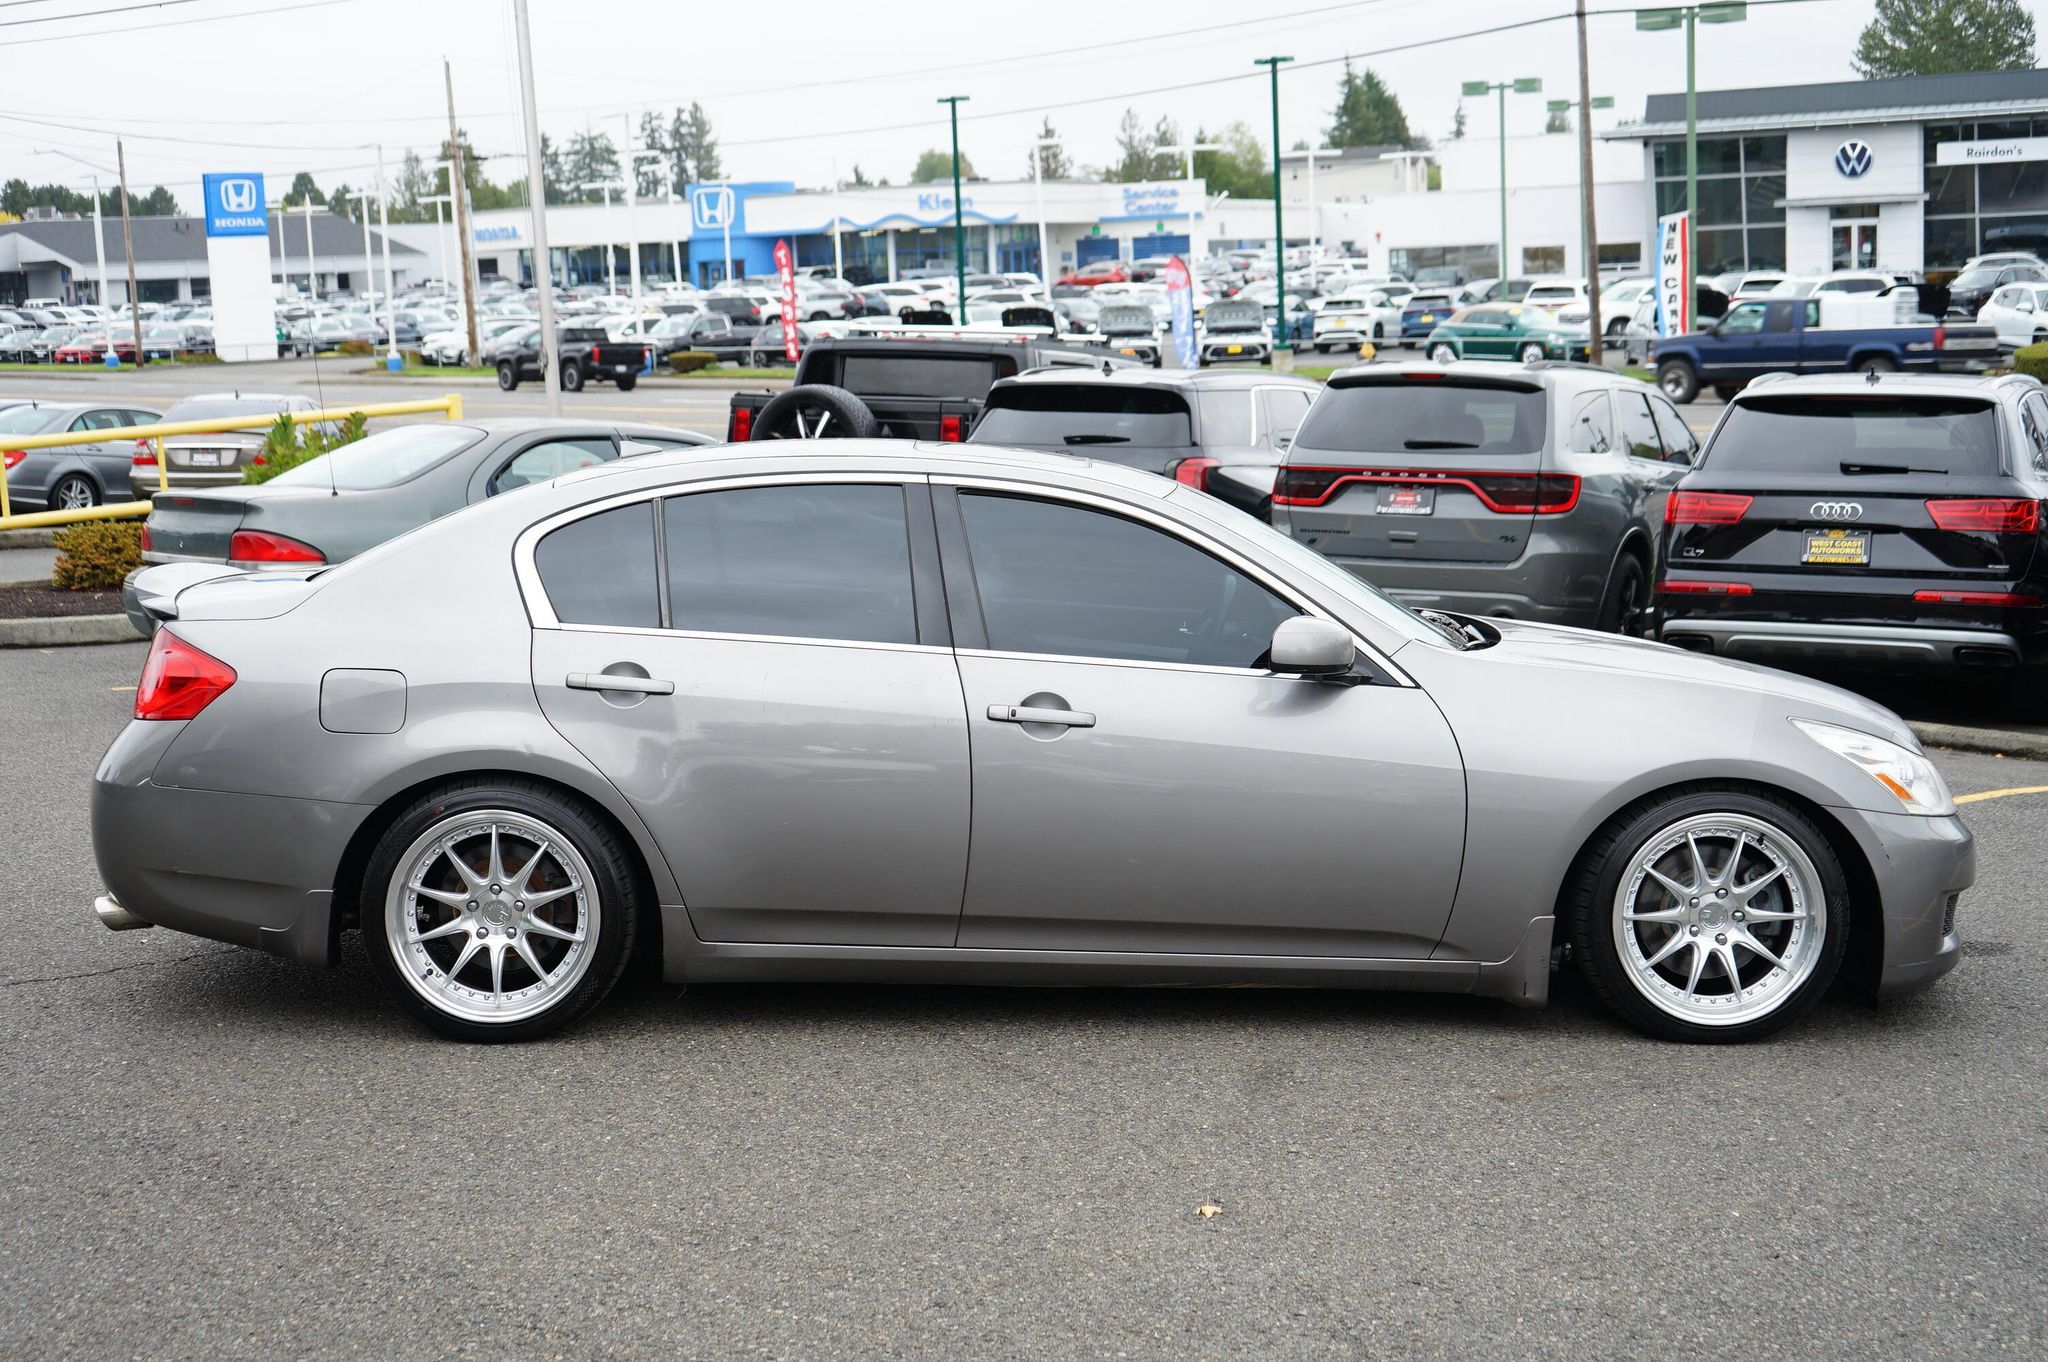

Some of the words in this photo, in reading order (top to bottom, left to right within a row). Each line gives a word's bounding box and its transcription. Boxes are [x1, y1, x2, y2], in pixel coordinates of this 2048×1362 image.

[1966, 145, 2023, 158] Rairdon's
[918, 193, 974, 209] Klen
[215, 217, 267, 228] HONDA
[1663, 221, 1678, 266] NEW
[776, 248, 798, 358] TRUCKS
[1362, 471, 1446, 479] DODGE
[1834, 540, 1862, 548] COAST
[1683, 546, 1705, 558] Q7
